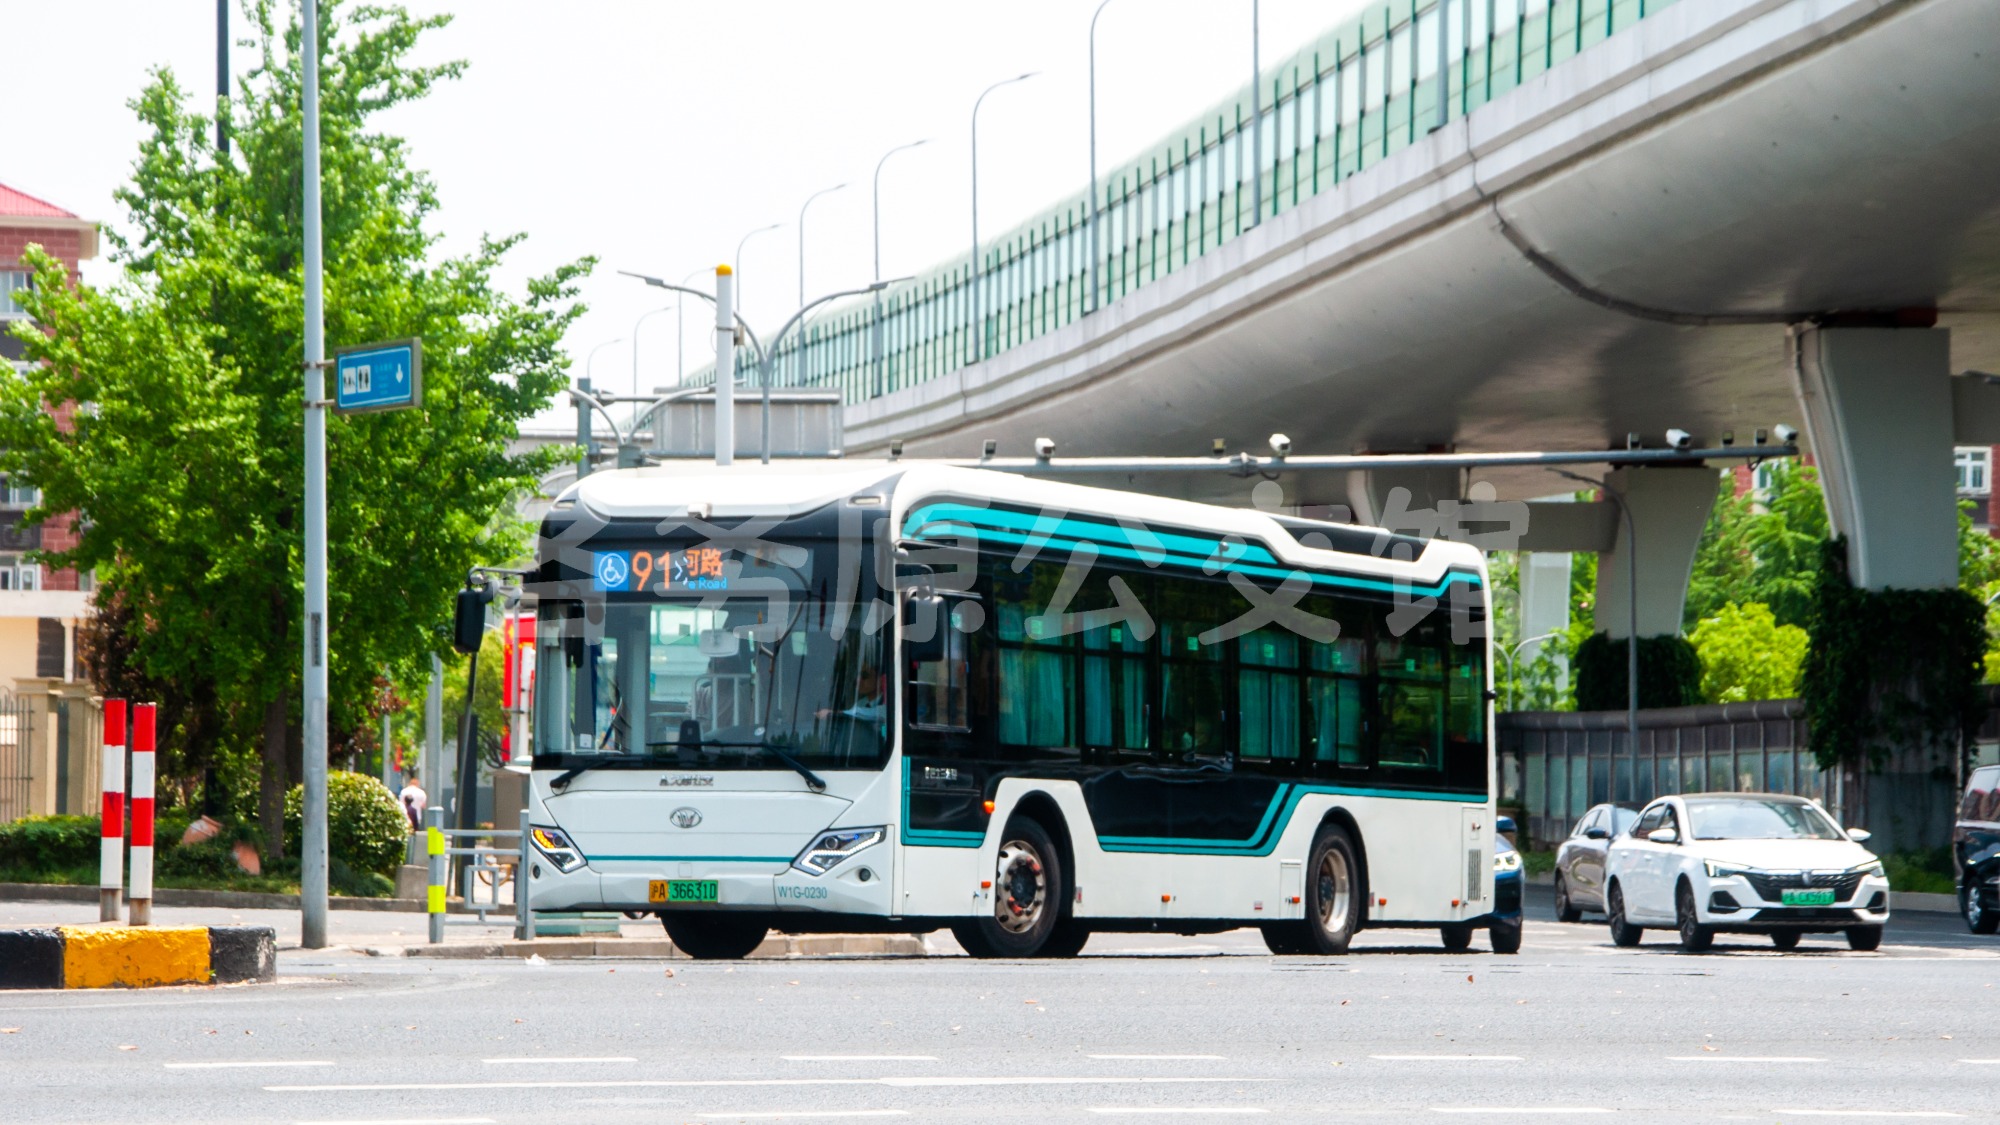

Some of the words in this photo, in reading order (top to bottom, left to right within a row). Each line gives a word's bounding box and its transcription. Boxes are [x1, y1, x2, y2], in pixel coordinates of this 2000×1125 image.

[632, 551, 670, 591] 91
[698, 577, 727, 590] Road
[671, 883, 717, 899] 36631D
[777, 886, 828, 899] W1G-0230
